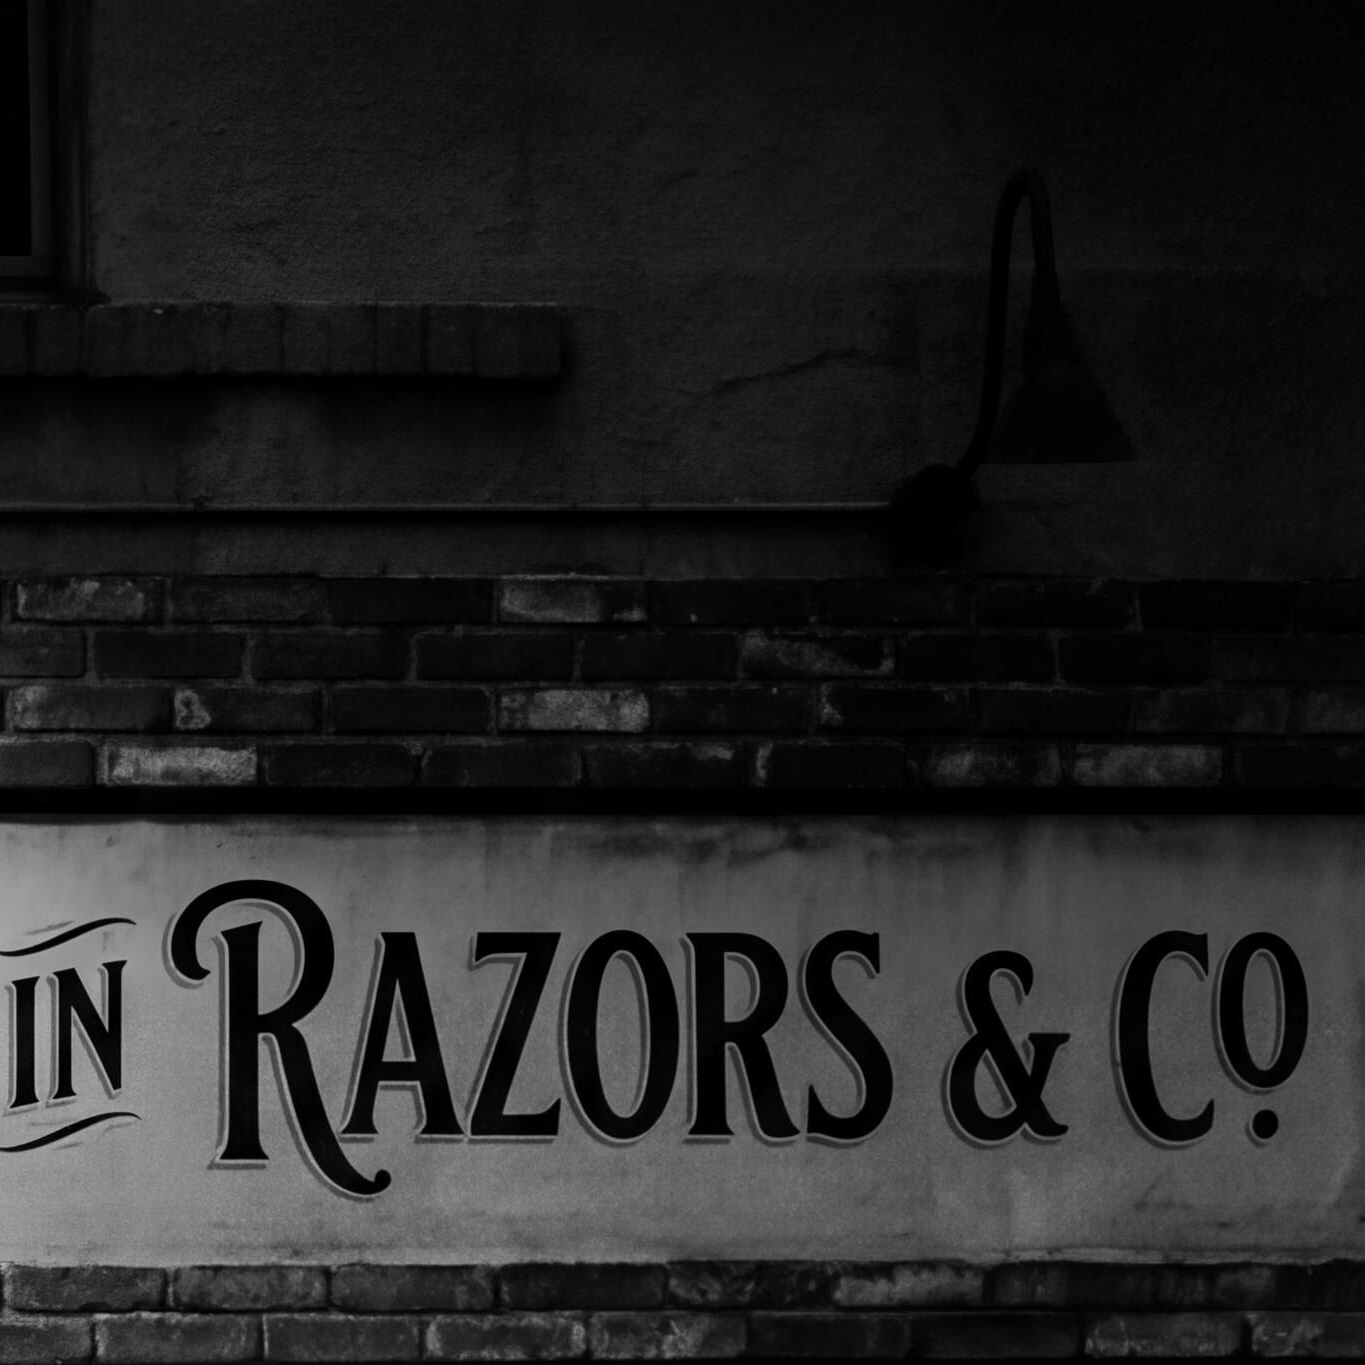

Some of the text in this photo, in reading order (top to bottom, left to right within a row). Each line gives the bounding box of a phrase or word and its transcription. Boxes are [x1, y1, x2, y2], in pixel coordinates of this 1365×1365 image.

[4, 957, 129, 1113] IN
[167, 879, 895, 1199] RAZORS
[945, 951, 1070, 1146] &
